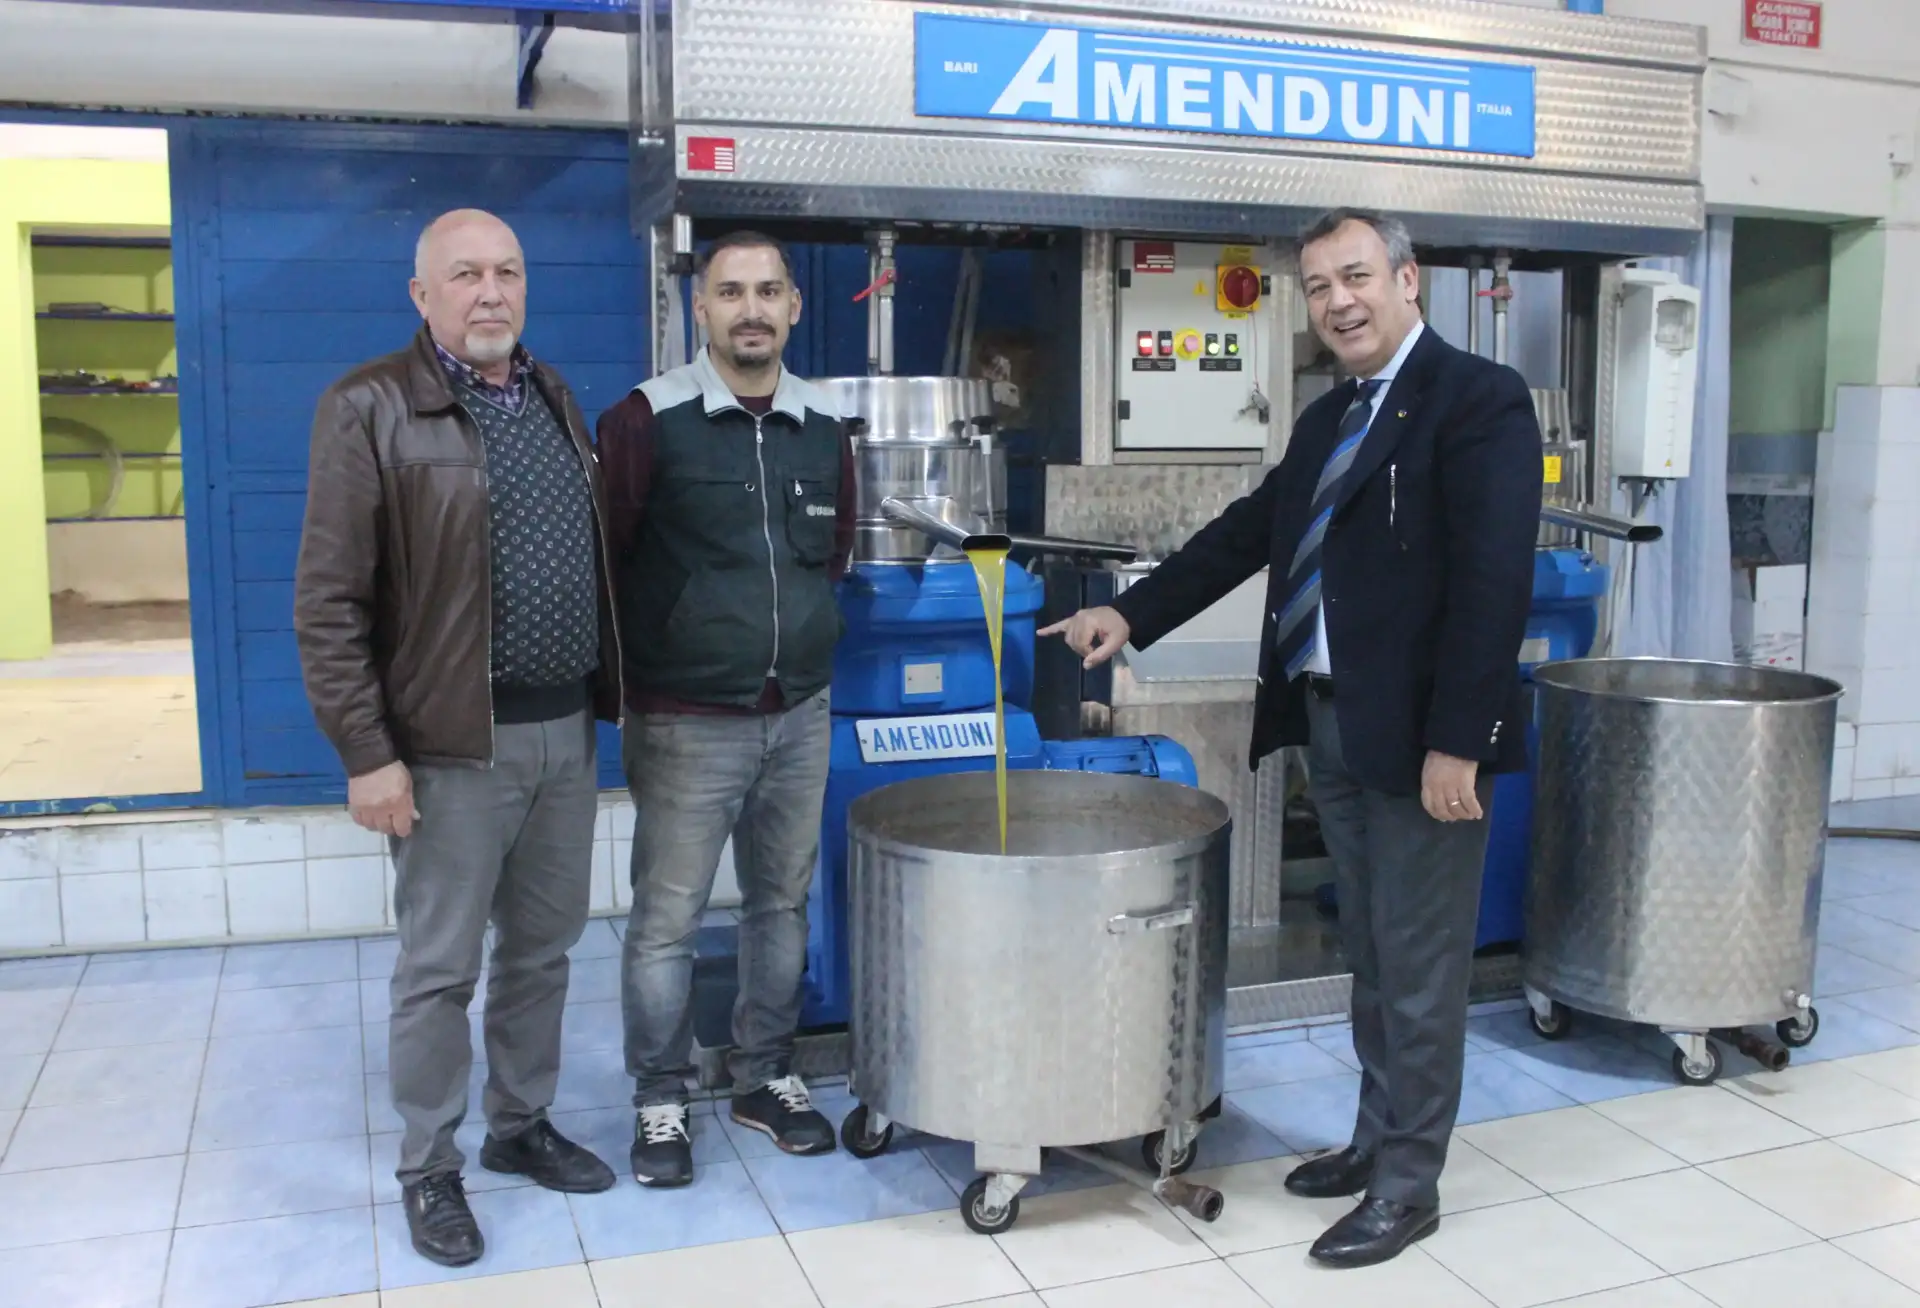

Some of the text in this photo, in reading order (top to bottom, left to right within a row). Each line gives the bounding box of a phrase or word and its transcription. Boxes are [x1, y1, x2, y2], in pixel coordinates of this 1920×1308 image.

[944, 61, 978, 74] BARI
[988, 28, 1470, 148] AMENDUNI
[1476, 103, 1513, 117] ITALIA
[873, 721, 995, 753] AMENDUNI
